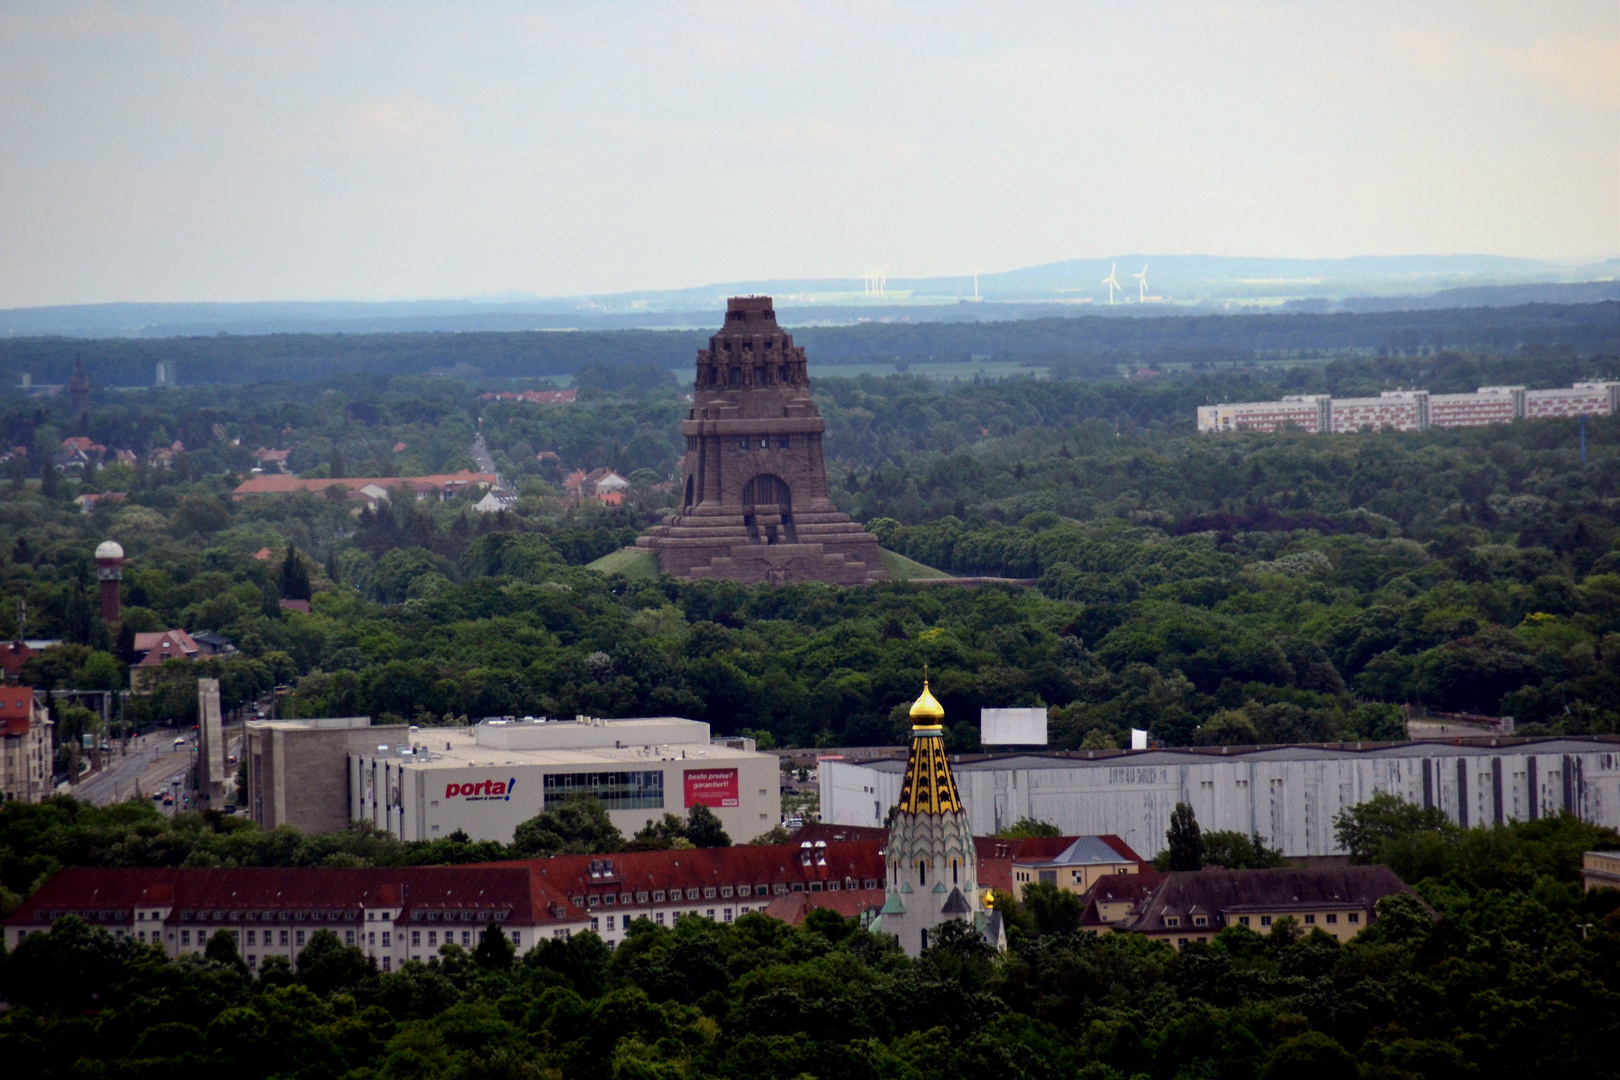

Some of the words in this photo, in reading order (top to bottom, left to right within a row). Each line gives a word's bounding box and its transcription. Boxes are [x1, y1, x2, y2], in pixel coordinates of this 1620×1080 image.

[708, 772, 734, 780] preise?
[445, 777, 516, 801] porta!
[693, 781, 729, 790] garantiert!
